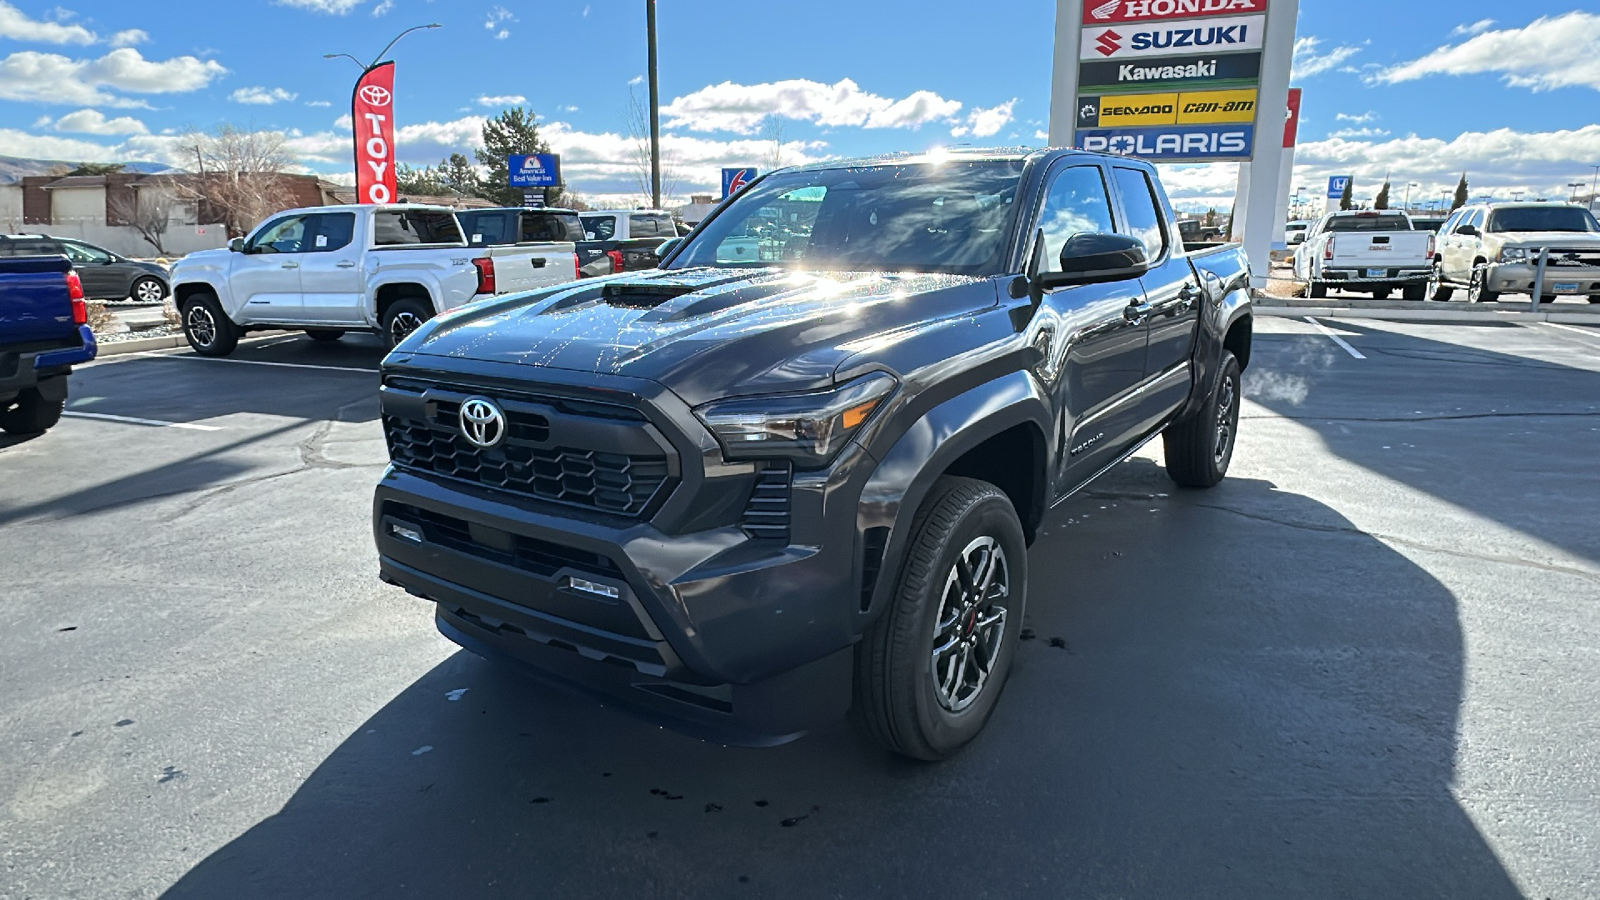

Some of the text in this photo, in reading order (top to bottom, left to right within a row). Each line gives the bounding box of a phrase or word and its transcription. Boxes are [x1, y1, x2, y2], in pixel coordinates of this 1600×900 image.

[1124, 0, 1255, 17] HONDA
[1131, 25, 1248, 50] SUZUKI
[1118, 59, 1217, 81] Kawasaki
[1083, 131, 1246, 154] POLARIS
